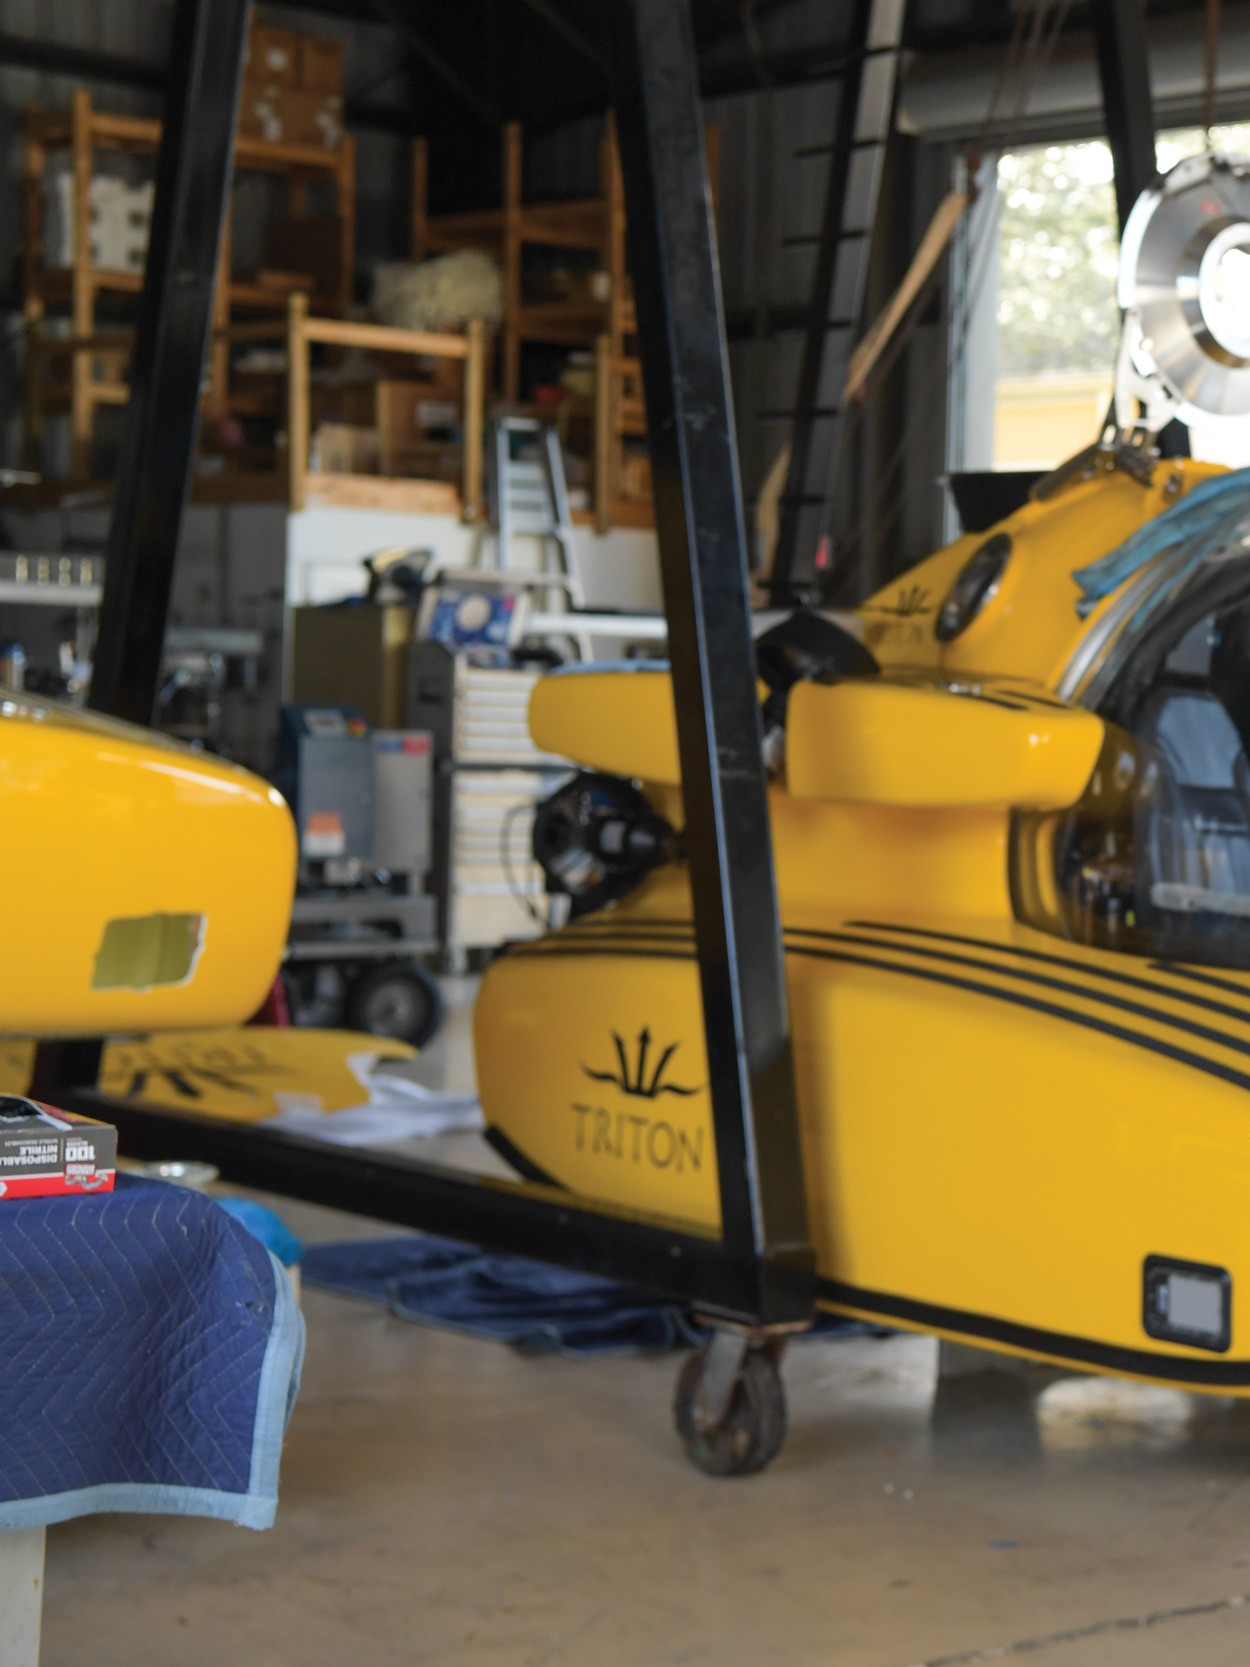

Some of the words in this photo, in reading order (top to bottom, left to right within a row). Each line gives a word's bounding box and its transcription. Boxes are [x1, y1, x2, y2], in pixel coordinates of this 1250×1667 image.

[571, 1102, 704, 1175] TRITON
[0, 1154, 58, 1166] DISPOSABL
[65, 1145, 96, 1162] 100
